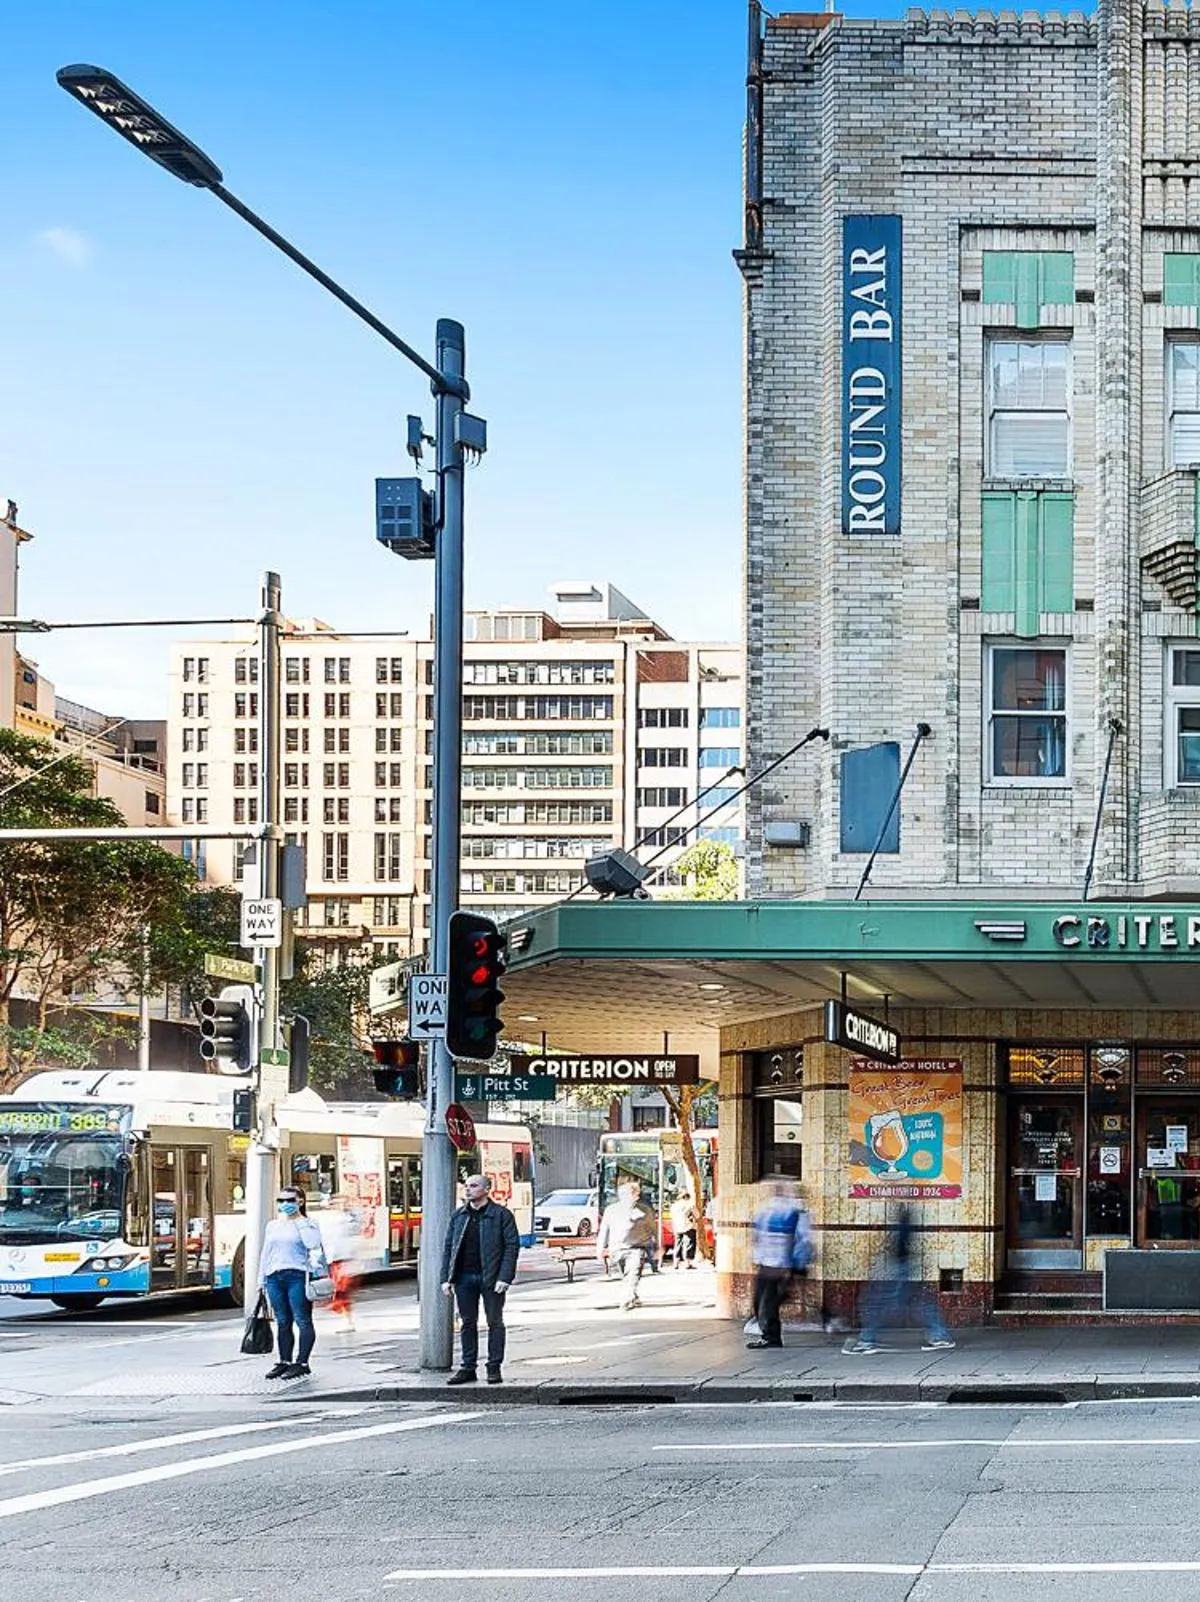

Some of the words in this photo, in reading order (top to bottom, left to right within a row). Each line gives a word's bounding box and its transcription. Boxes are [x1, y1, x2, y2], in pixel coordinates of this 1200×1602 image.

[850, 246, 893, 342] BAR
[849, 367, 886, 532] ROUND
[248, 904, 275, 915] ONE
[246, 918, 276, 929] WAY
[415, 1000, 447, 1015] WA
[845, 1012, 889, 1053] CRITERION
[528, 1060, 649, 1079] CRITERION
[917, 1061, 947, 1070] HOTEL
[484, 1078, 510, 1091] Pitt
[513, 1077, 529, 1091] St
[448, 1117, 473, 1138] STOP
[869, 1186, 919, 1197] ESTABLISHED
